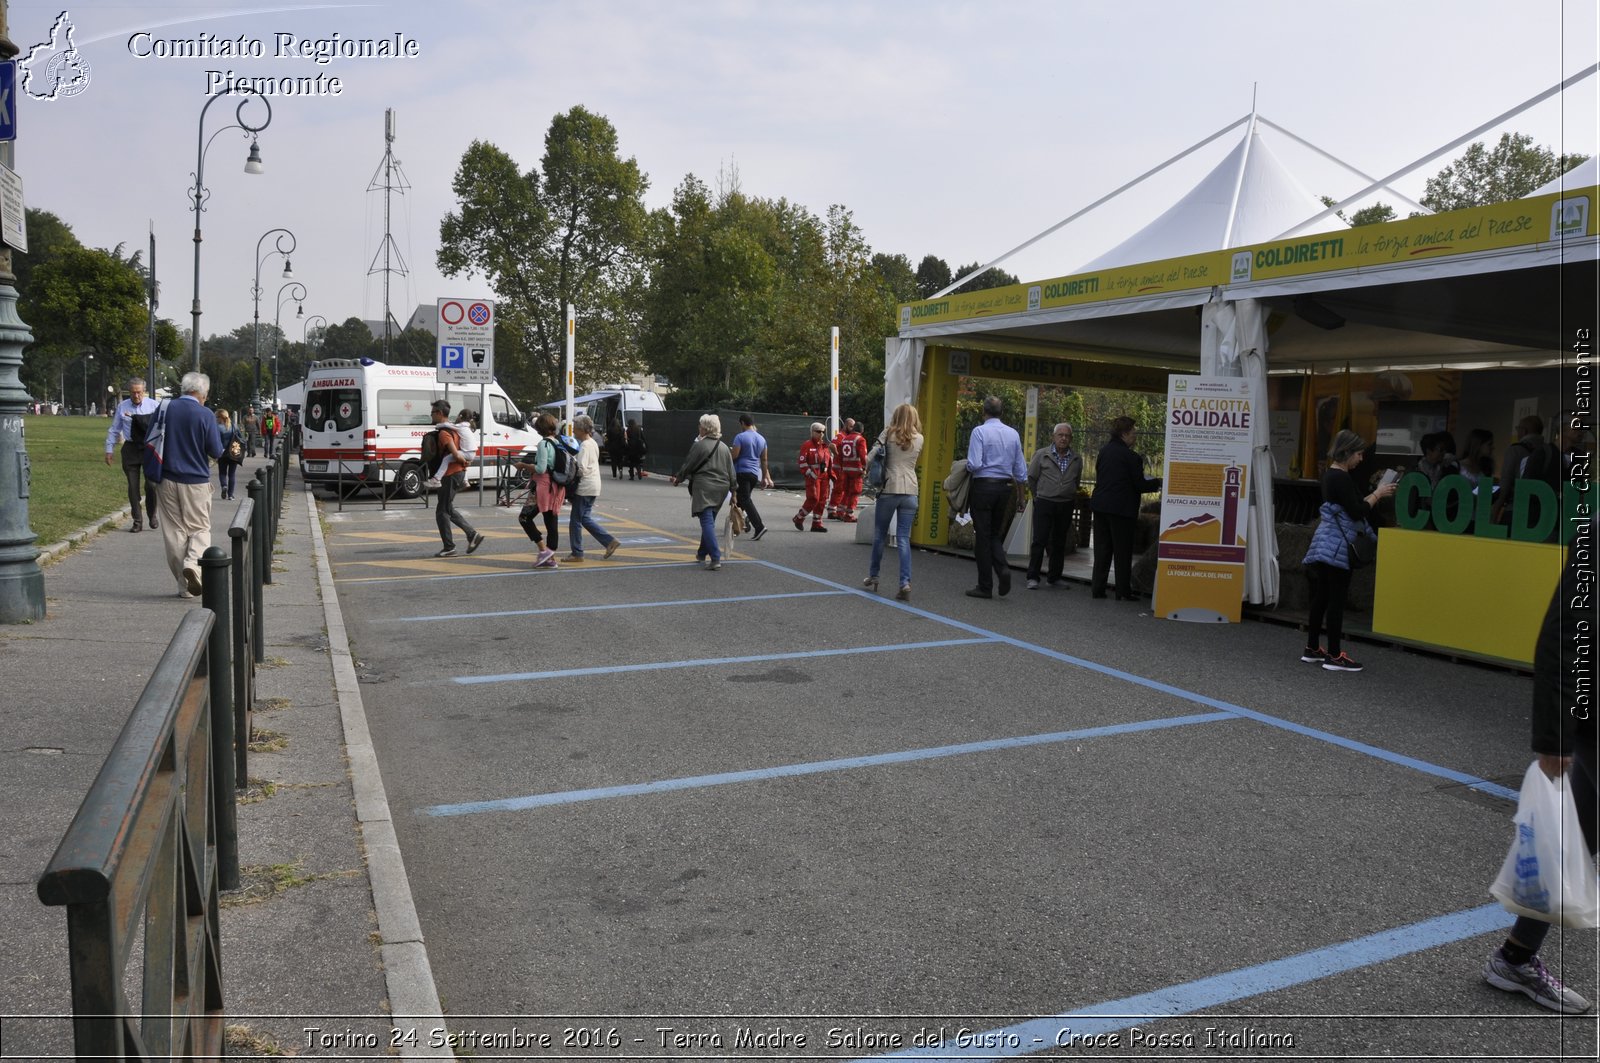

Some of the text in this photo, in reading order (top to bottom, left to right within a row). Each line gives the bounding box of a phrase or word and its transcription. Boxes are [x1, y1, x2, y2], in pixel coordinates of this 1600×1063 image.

[1255, 238, 1344, 269] COLDIRETTI
[1373, 235, 1409, 257] forza
[1413, 229, 1455, 247] amica
[1459, 216, 1484, 240] del
[1488, 215, 1533, 237] Paese
[1044, 277, 1099, 299] COLDIRETTI
[1166, 266, 1180, 282] del
[1183, 265, 1209, 281] Paese
[911, 301, 949, 319] COLDIRETTI
[445, 348, 460, 367] P
[980, 354, 1073, 378] COLDIRETTI
[312, 378, 355, 388] AMBULANZA
[1172, 397, 1250, 411] LA CACIOTTA
[1171, 410, 1251, 428] SOLIDALE
[930, 480, 941, 539] COLDIRETTI
